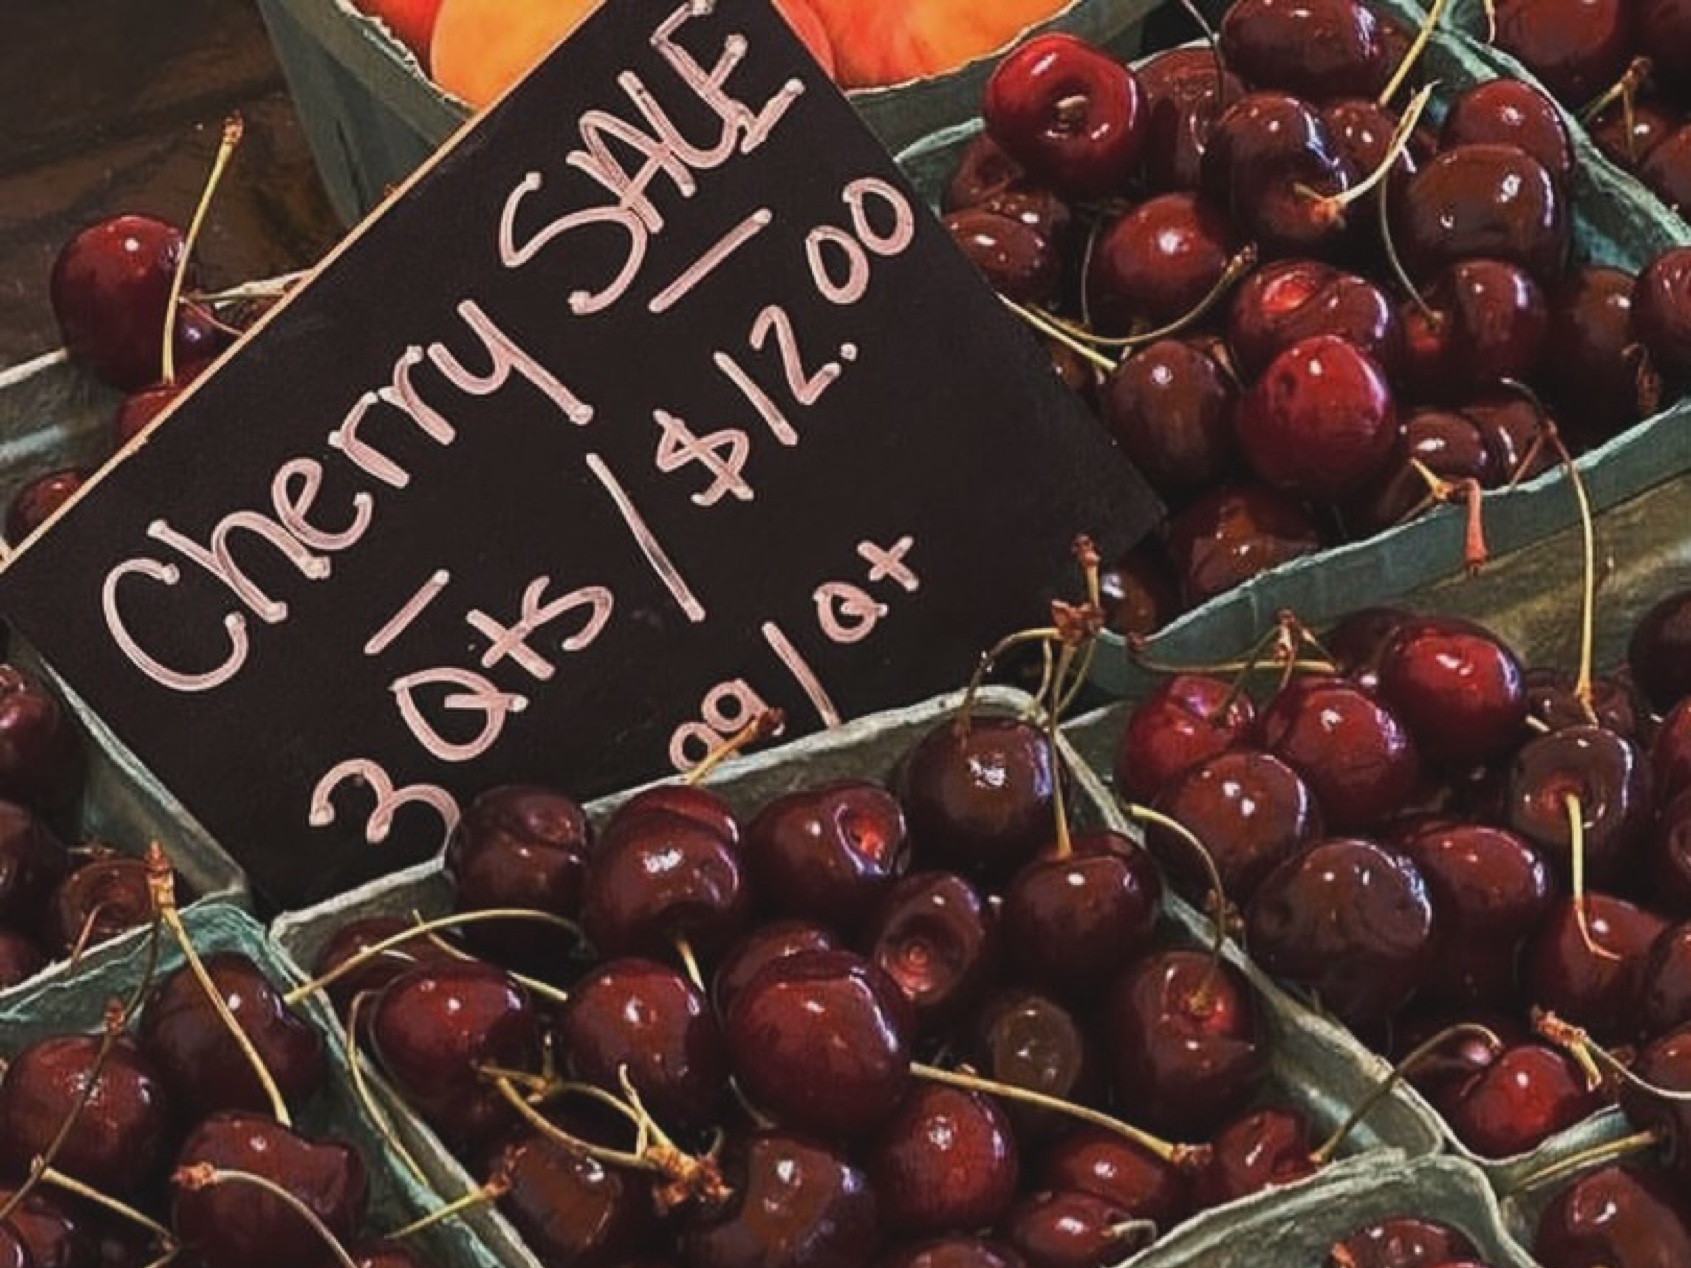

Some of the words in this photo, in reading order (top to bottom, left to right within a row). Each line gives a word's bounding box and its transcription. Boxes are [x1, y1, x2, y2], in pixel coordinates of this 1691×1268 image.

[101, 299, 594, 692] Cherry
[498, 0, 805, 315] SALE
[308, 757, 461, 862] 3
[389, 574, 614, 762] Qts
[652, 177, 915, 506] $12.00
